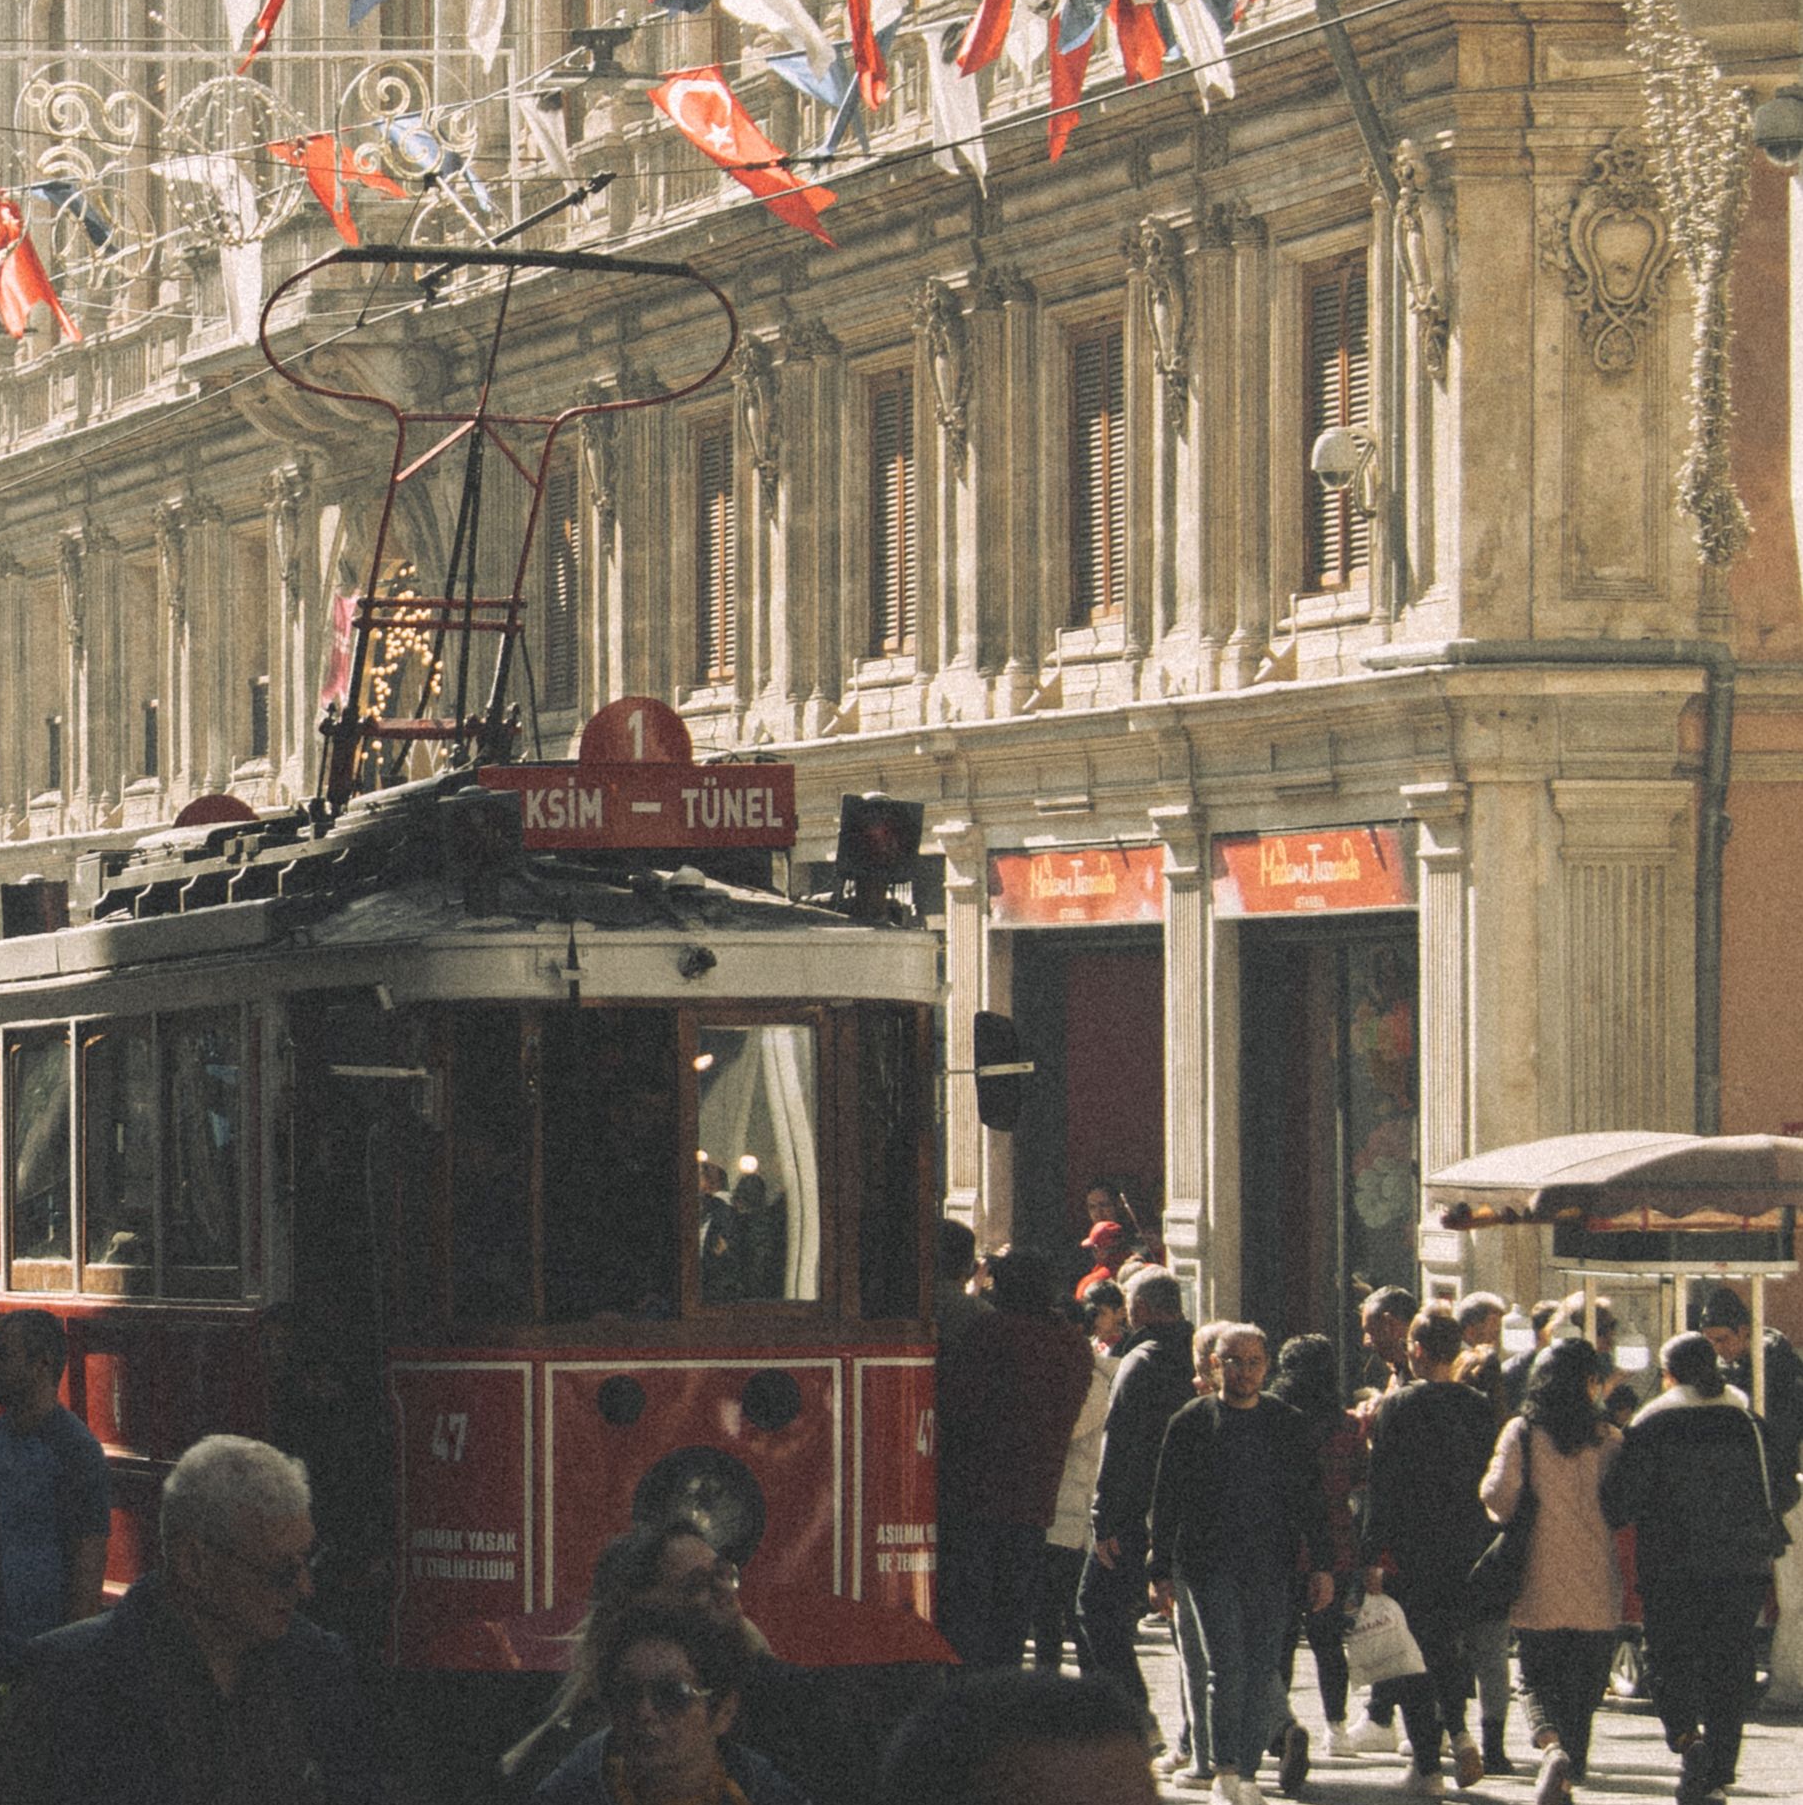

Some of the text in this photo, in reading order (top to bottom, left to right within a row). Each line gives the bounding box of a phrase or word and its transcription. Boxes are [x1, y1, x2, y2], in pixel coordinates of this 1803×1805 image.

[627, 709, 644, 760] 1
[522, 777, 603, 829] KSİM
[680, 777, 784, 829] TÜNEL
[429, 1412, 469, 1462] 47
[468, 1530, 517, 1552] YASAK
